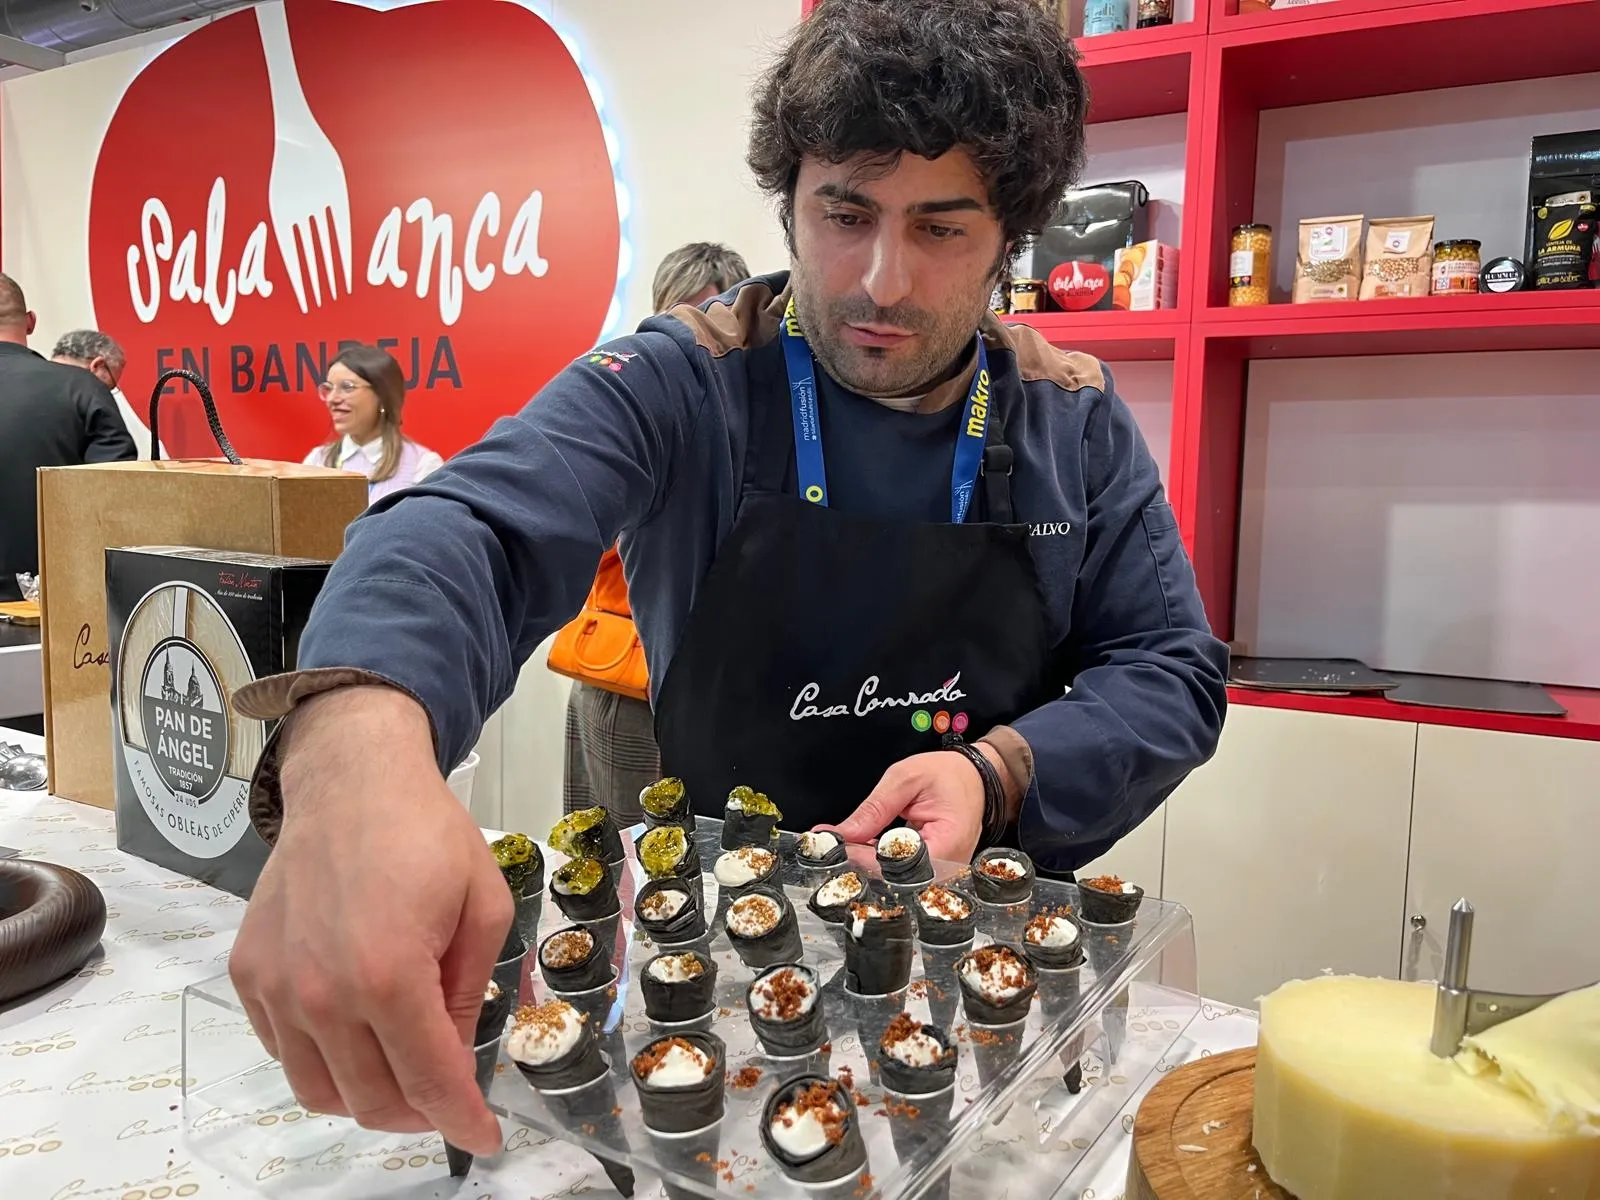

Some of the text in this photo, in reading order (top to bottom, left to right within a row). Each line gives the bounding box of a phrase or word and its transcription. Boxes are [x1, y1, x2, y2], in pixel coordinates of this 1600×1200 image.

[156, 336, 463, 395] EN BANJA
[967, 370, 989, 438] makro
[1029, 522, 1070, 537] ALVO
[790, 671, 967, 721] Casa Conrado
[155, 706, 213, 740] PAN DE
[157, 729, 214, 770] ÁNGEL
[168, 765, 204, 784] TRADICIÓN
[179, 779, 193, 791] 1857
[134, 760, 249, 841] FAMOSAS OBLEAS DE CIPÉREZ
[175, 793, 184, 803] 24
